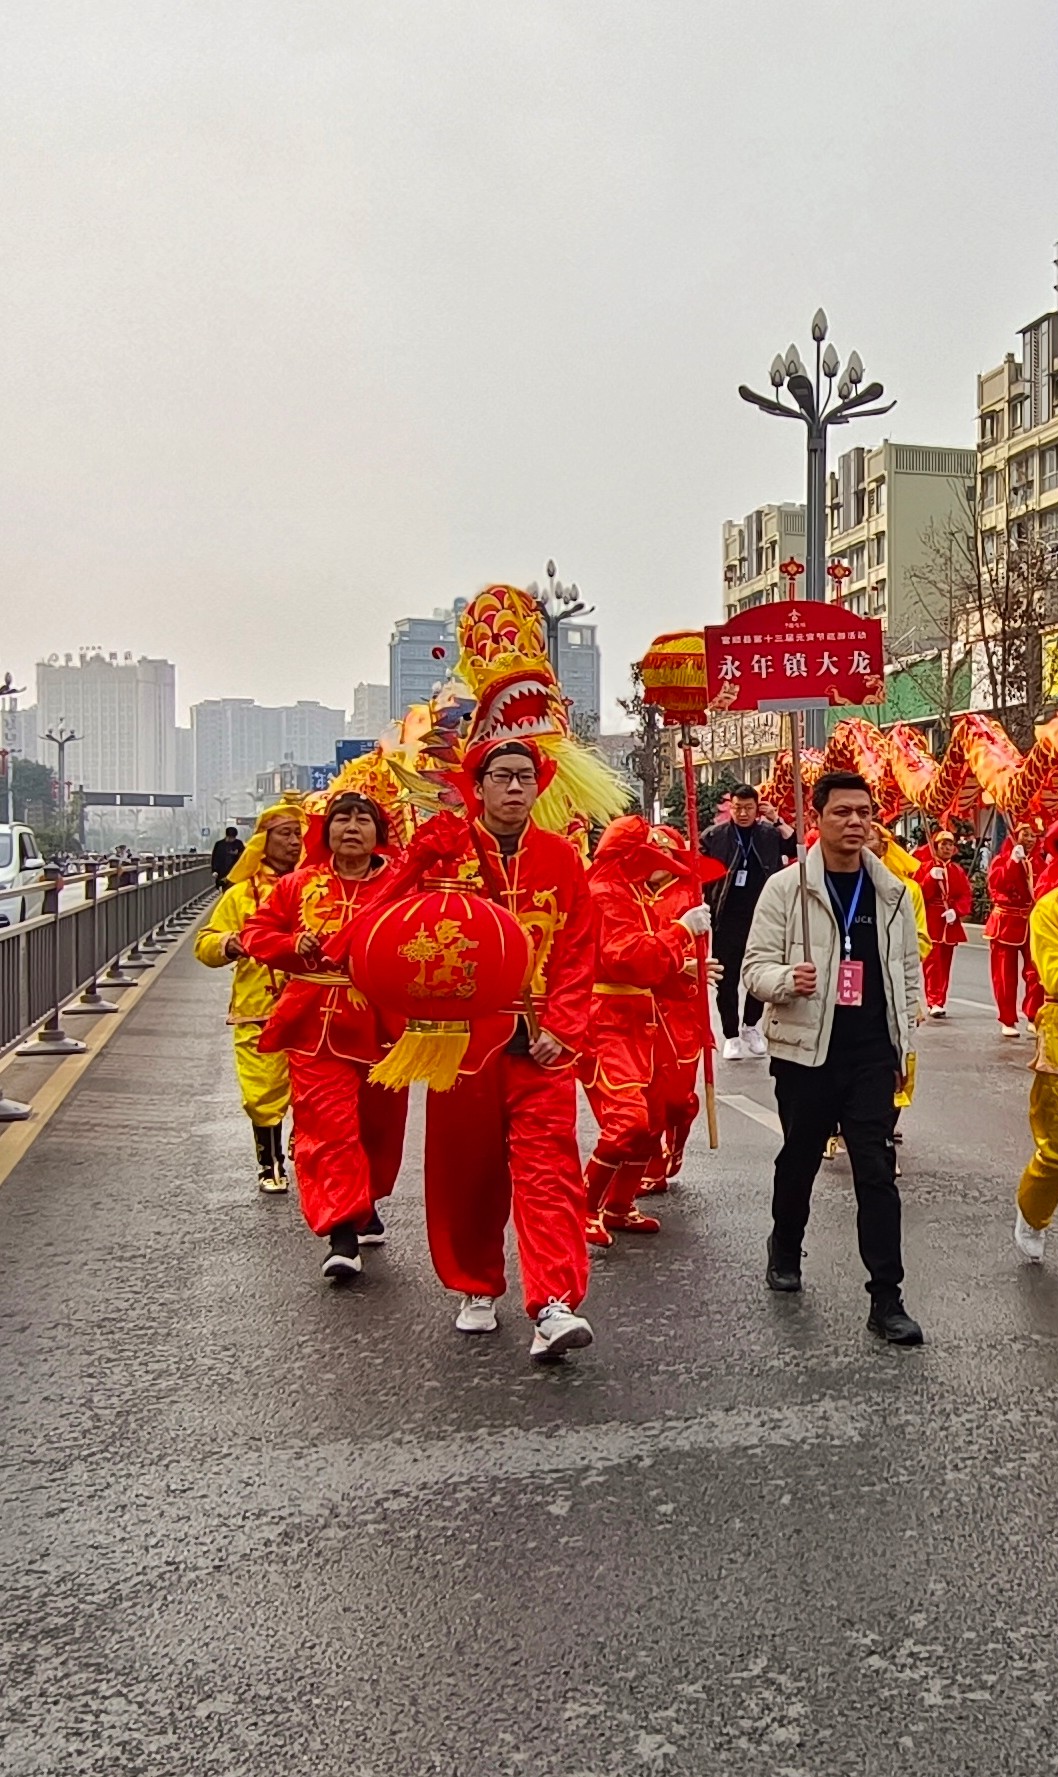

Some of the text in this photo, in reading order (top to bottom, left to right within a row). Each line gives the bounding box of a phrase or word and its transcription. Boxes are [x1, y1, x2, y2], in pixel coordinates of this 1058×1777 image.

[718, 650, 871, 680] 永年镇大龙
